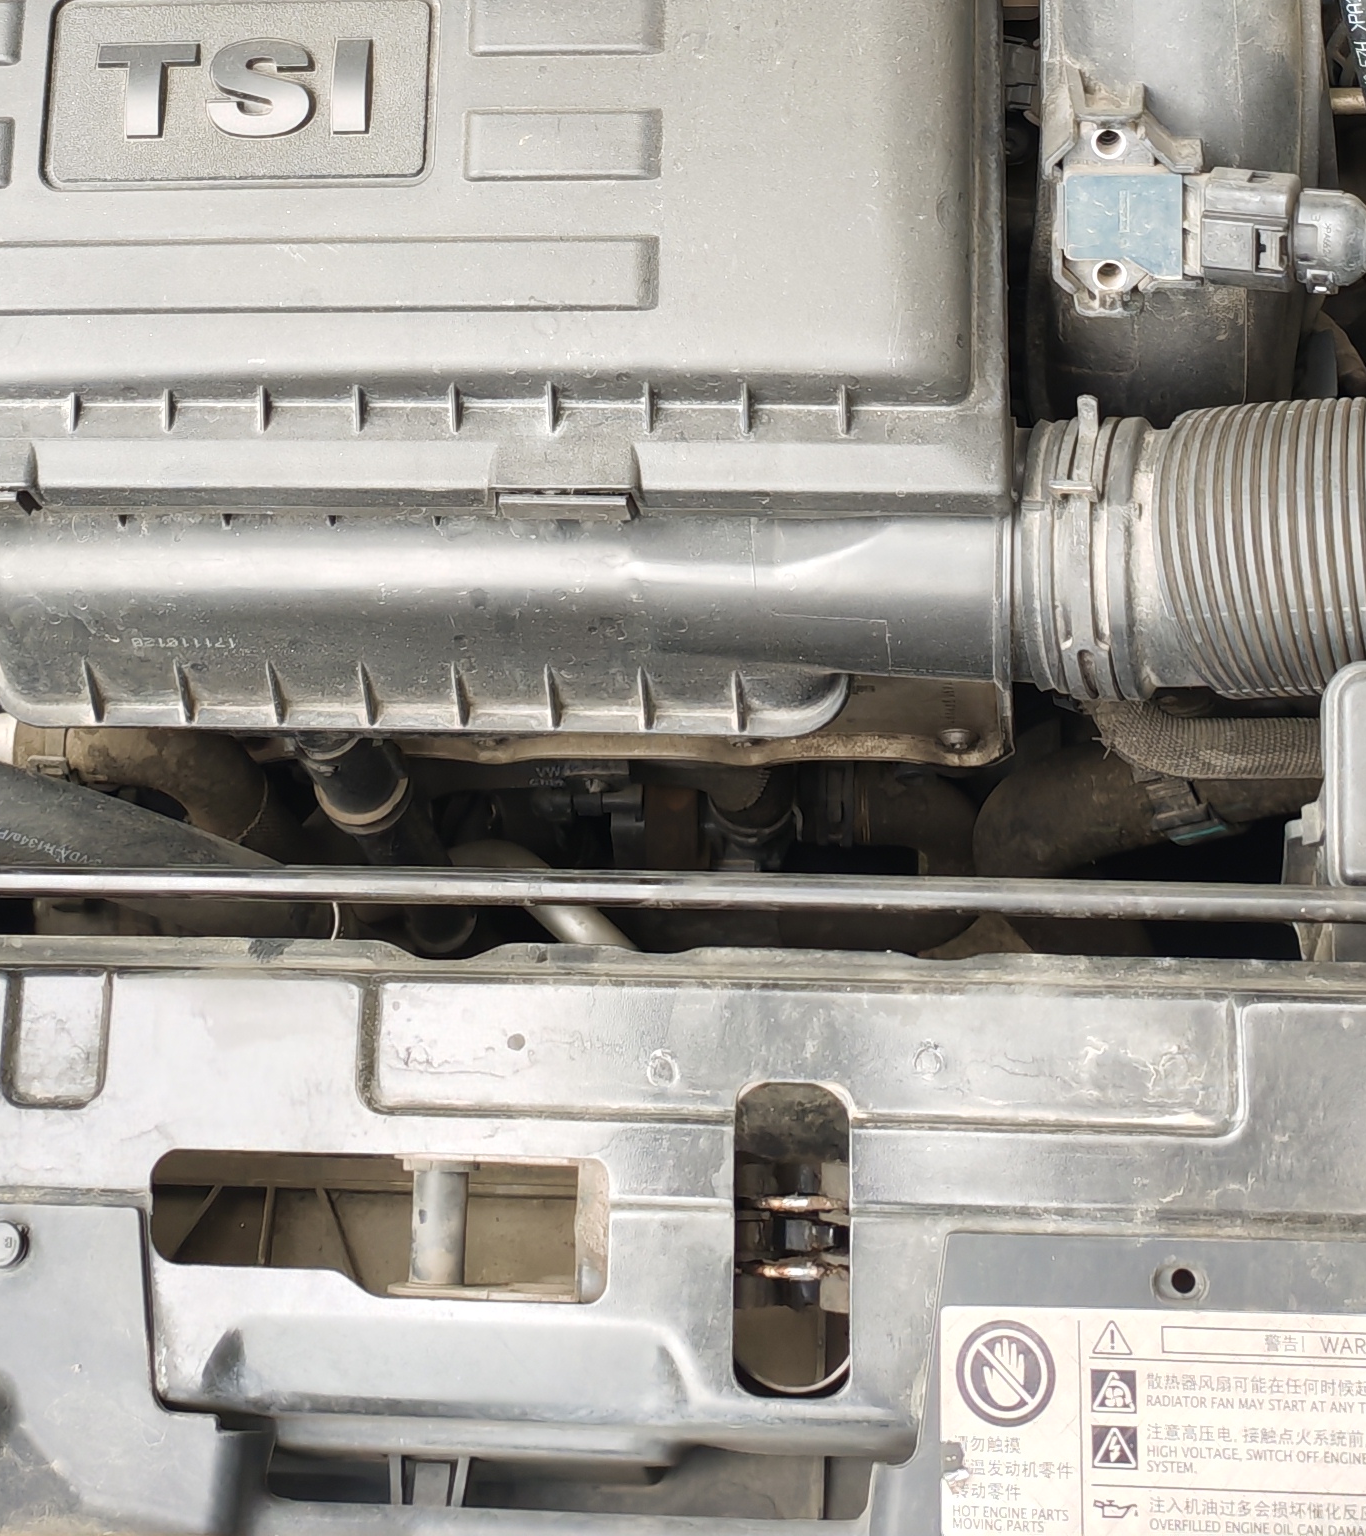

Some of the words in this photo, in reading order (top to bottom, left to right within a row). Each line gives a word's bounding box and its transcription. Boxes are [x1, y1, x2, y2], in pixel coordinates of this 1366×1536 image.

[96, 36, 375, 143] TSI
[1146, 1396, 1207, 1409] RADIATOR
[1210, 1397, 1235, 1410] FAN
[1237, 1398, 1265, 1411] MAY
[1268, 1399, 1306, 1412] START
[1310, 1400, 1326, 1413] AT
[1329, 1401, 1354, 1414] ANY
[1146, 1444, 1178, 1458] HIGH
[1245, 1448, 1293, 1462] SWITCH
[1296, 1450, 1320, 1463] OFF
[952, 1504, 979, 1517] HOT
[983, 1506, 1028, 1520] ENGINE
[1031, 1508, 1070, 1522] PARTS
[952, 1517, 1003, 1532] MOVING
[1006, 1519, 1046, 1533] PARTS
[1149, 1517, 1222, 1532] OVERFILLED
[1225, 1519, 1271, 1534] ENGINE
[1273, 1522, 1294, 1535] OIL
[1297, 1523, 1324, 1536] CAN
